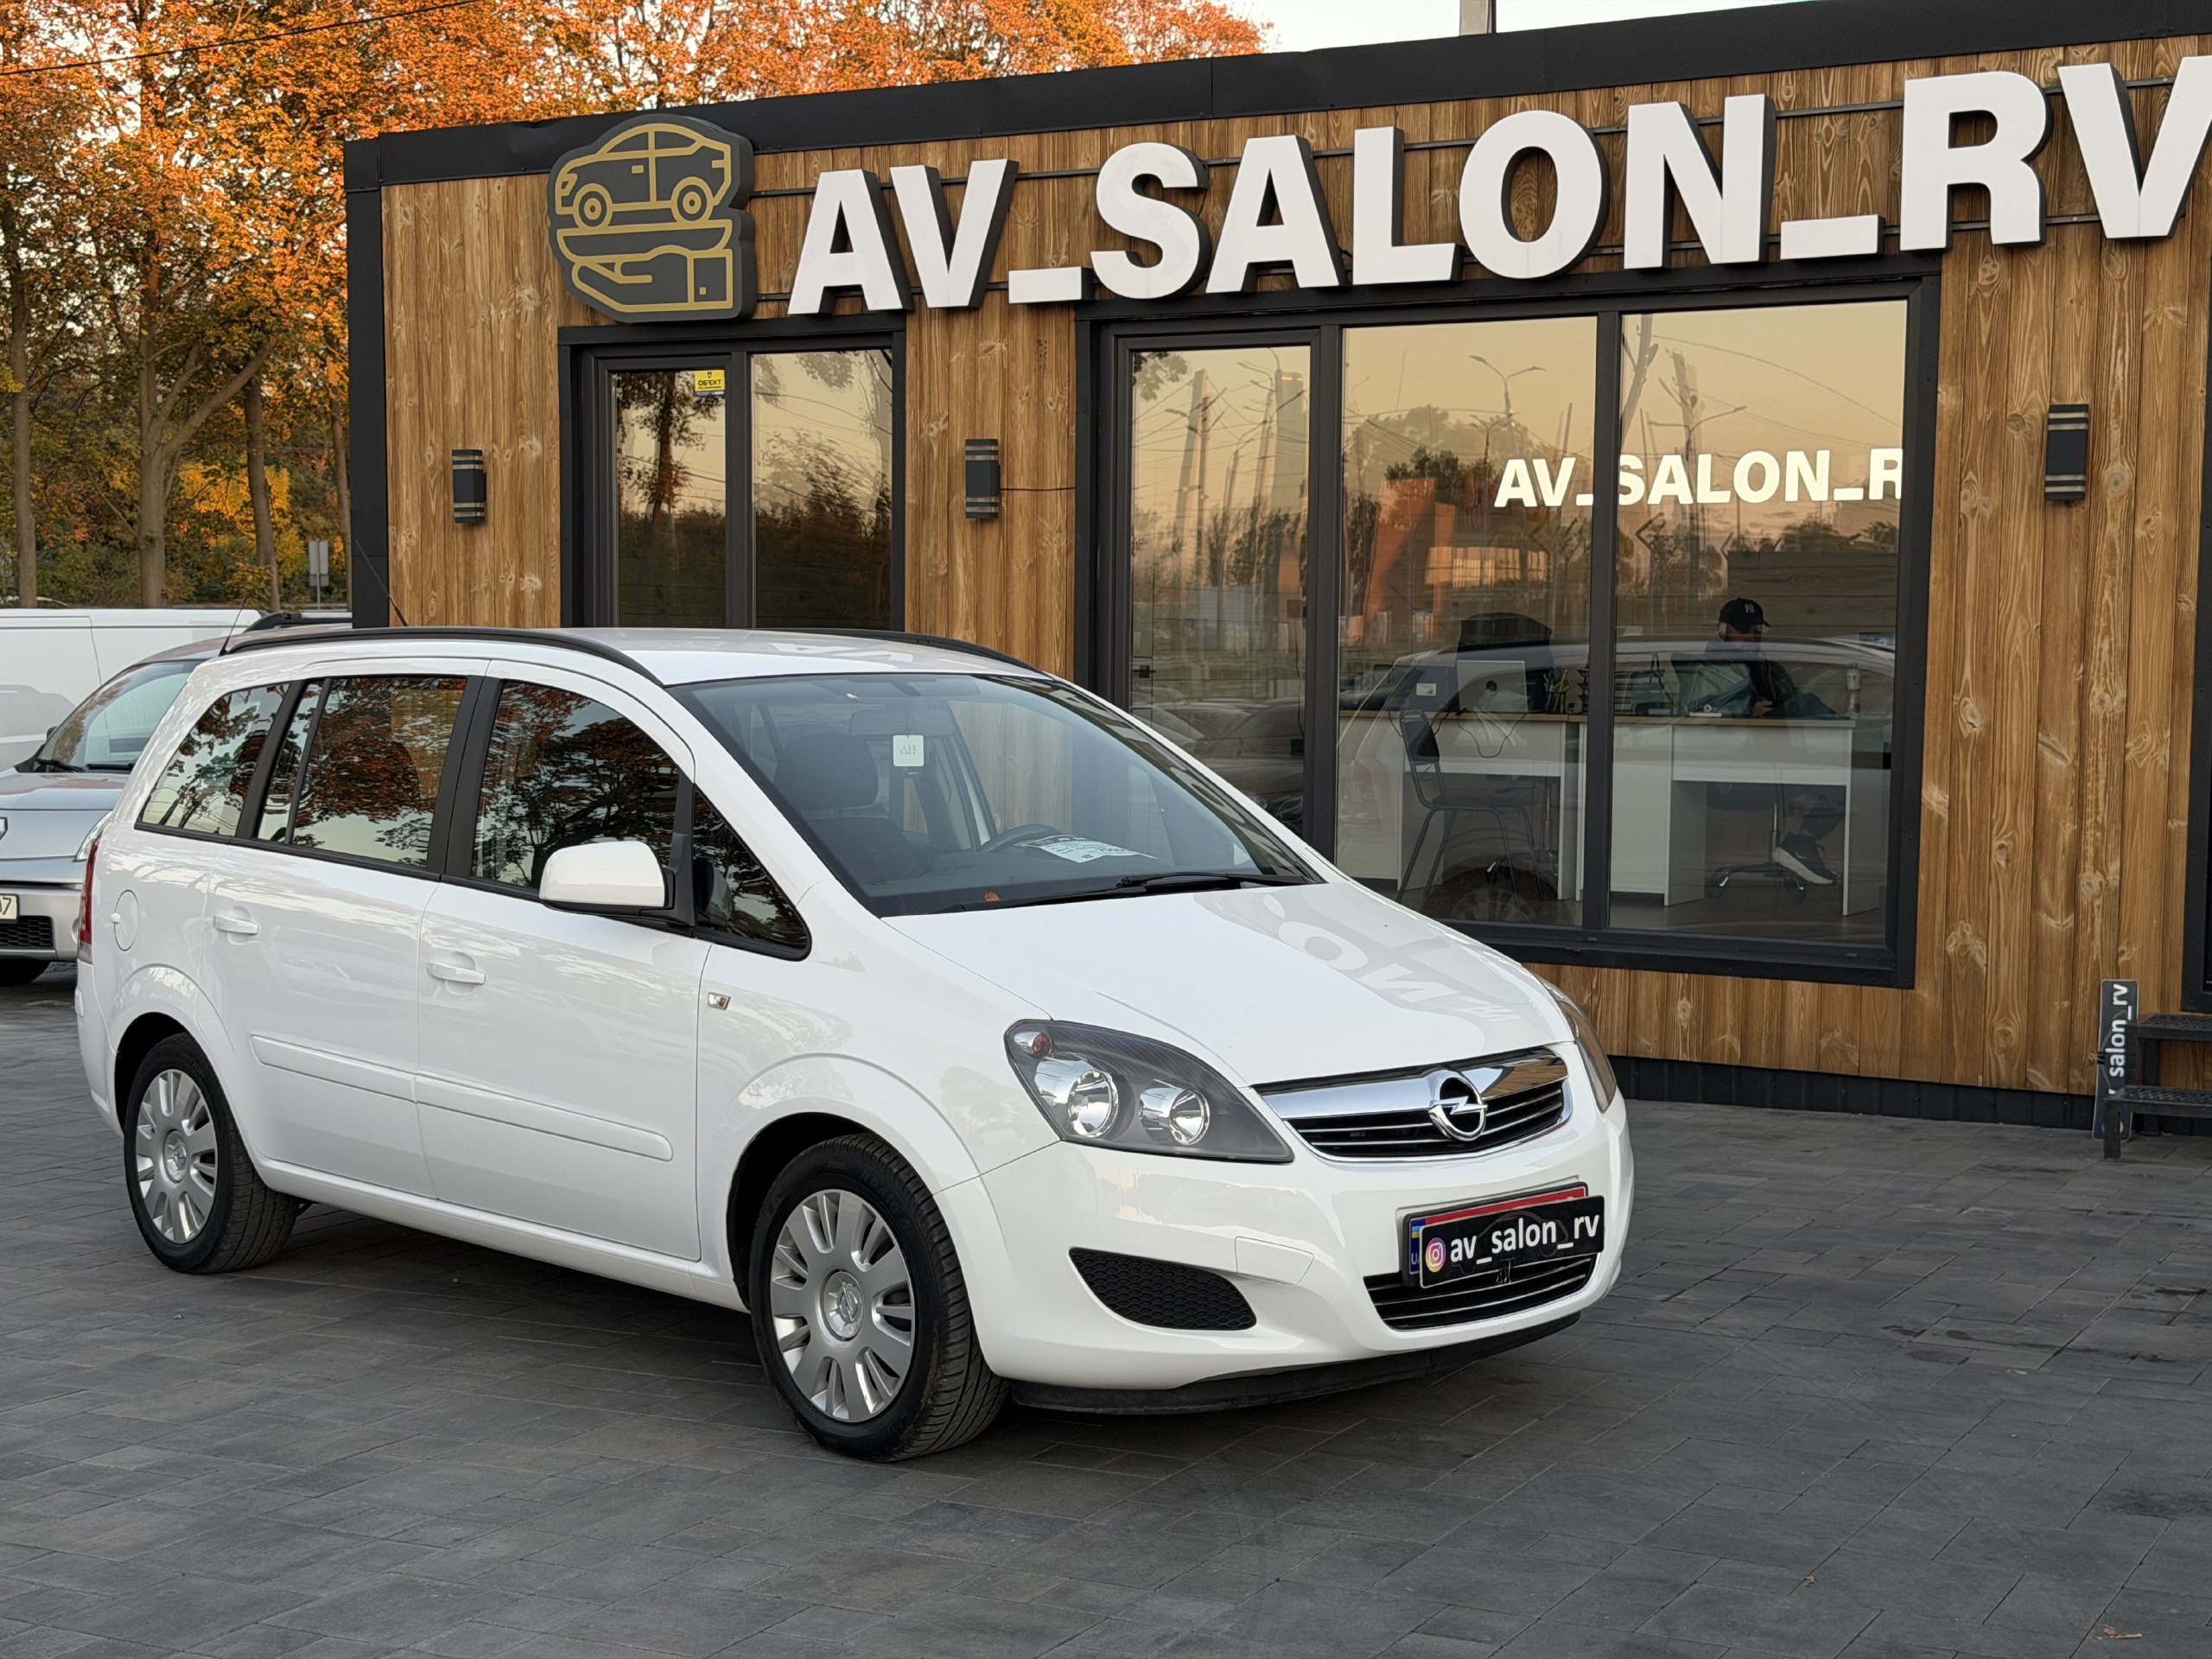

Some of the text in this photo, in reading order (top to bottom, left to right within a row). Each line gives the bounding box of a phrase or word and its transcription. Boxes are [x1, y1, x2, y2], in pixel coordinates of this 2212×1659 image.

[788, 54, 2212, 315] AV_SALON_RV
[0, 897, 12, 915] 7
[1450, 1215, 1599, 1265] av_salon_rv
